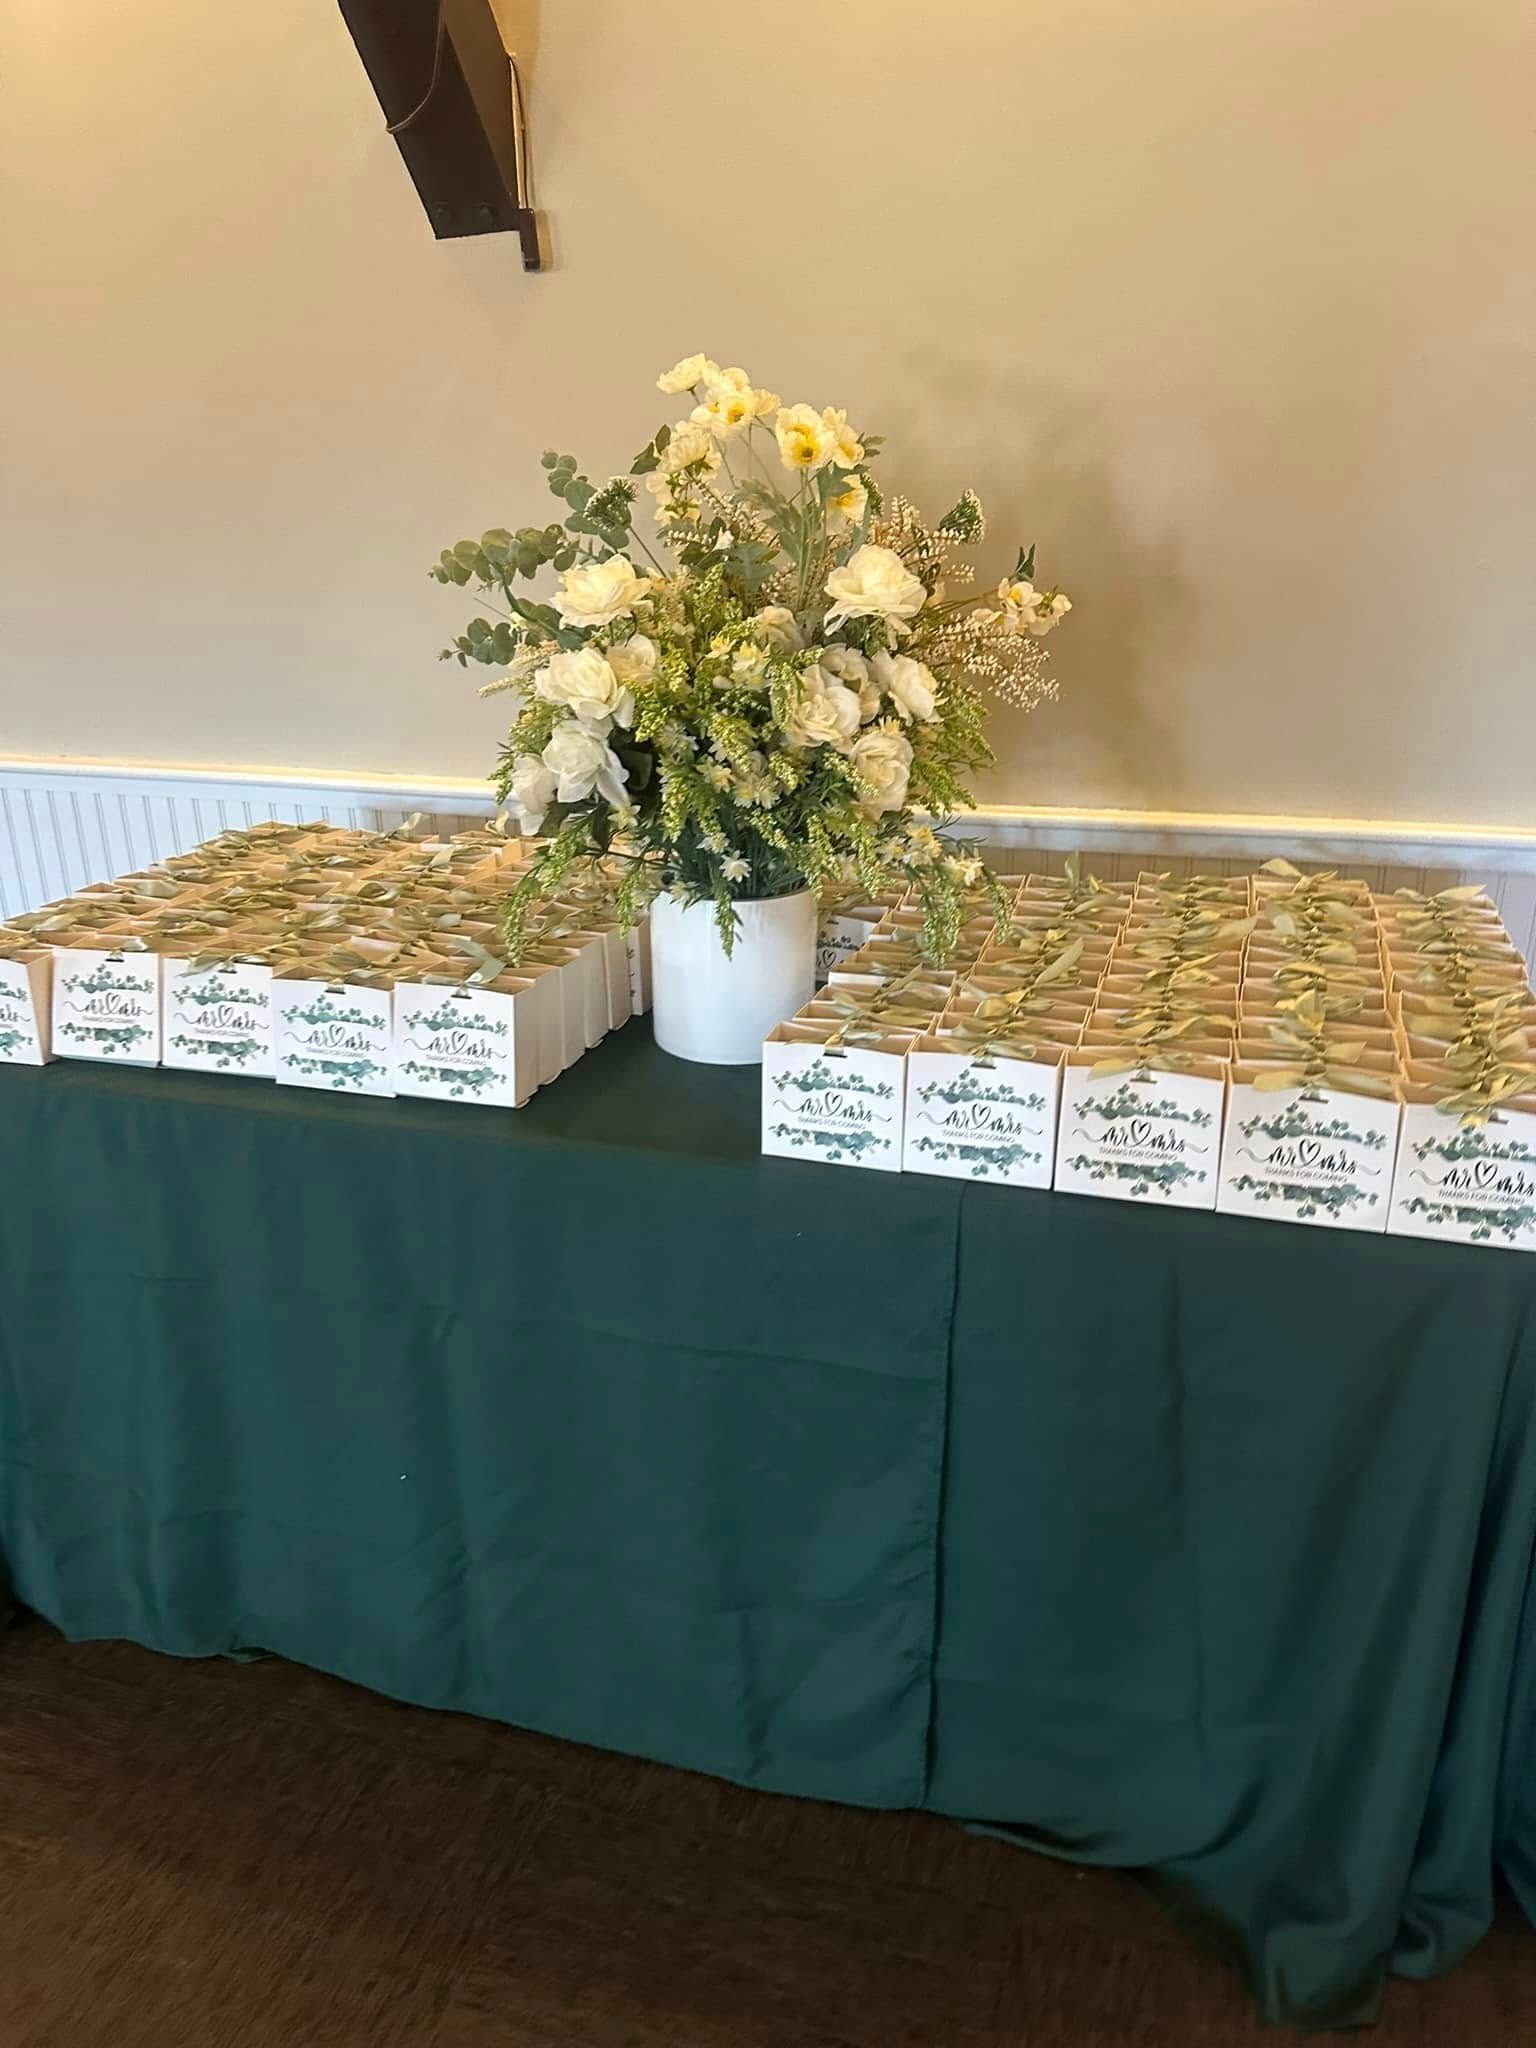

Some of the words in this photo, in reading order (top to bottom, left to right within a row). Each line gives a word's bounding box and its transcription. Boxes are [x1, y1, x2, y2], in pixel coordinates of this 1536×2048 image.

[1264, 1167, 1294, 1178] THANKS
[1295, 1170, 1312, 1179] FOR
[1313, 1172, 1349, 1183] COMING
[1439, 1189, 1469, 1200] THANKS
[1470, 1190, 1488, 1201] FOR
[1489, 1192, 1526, 1205] COMING
